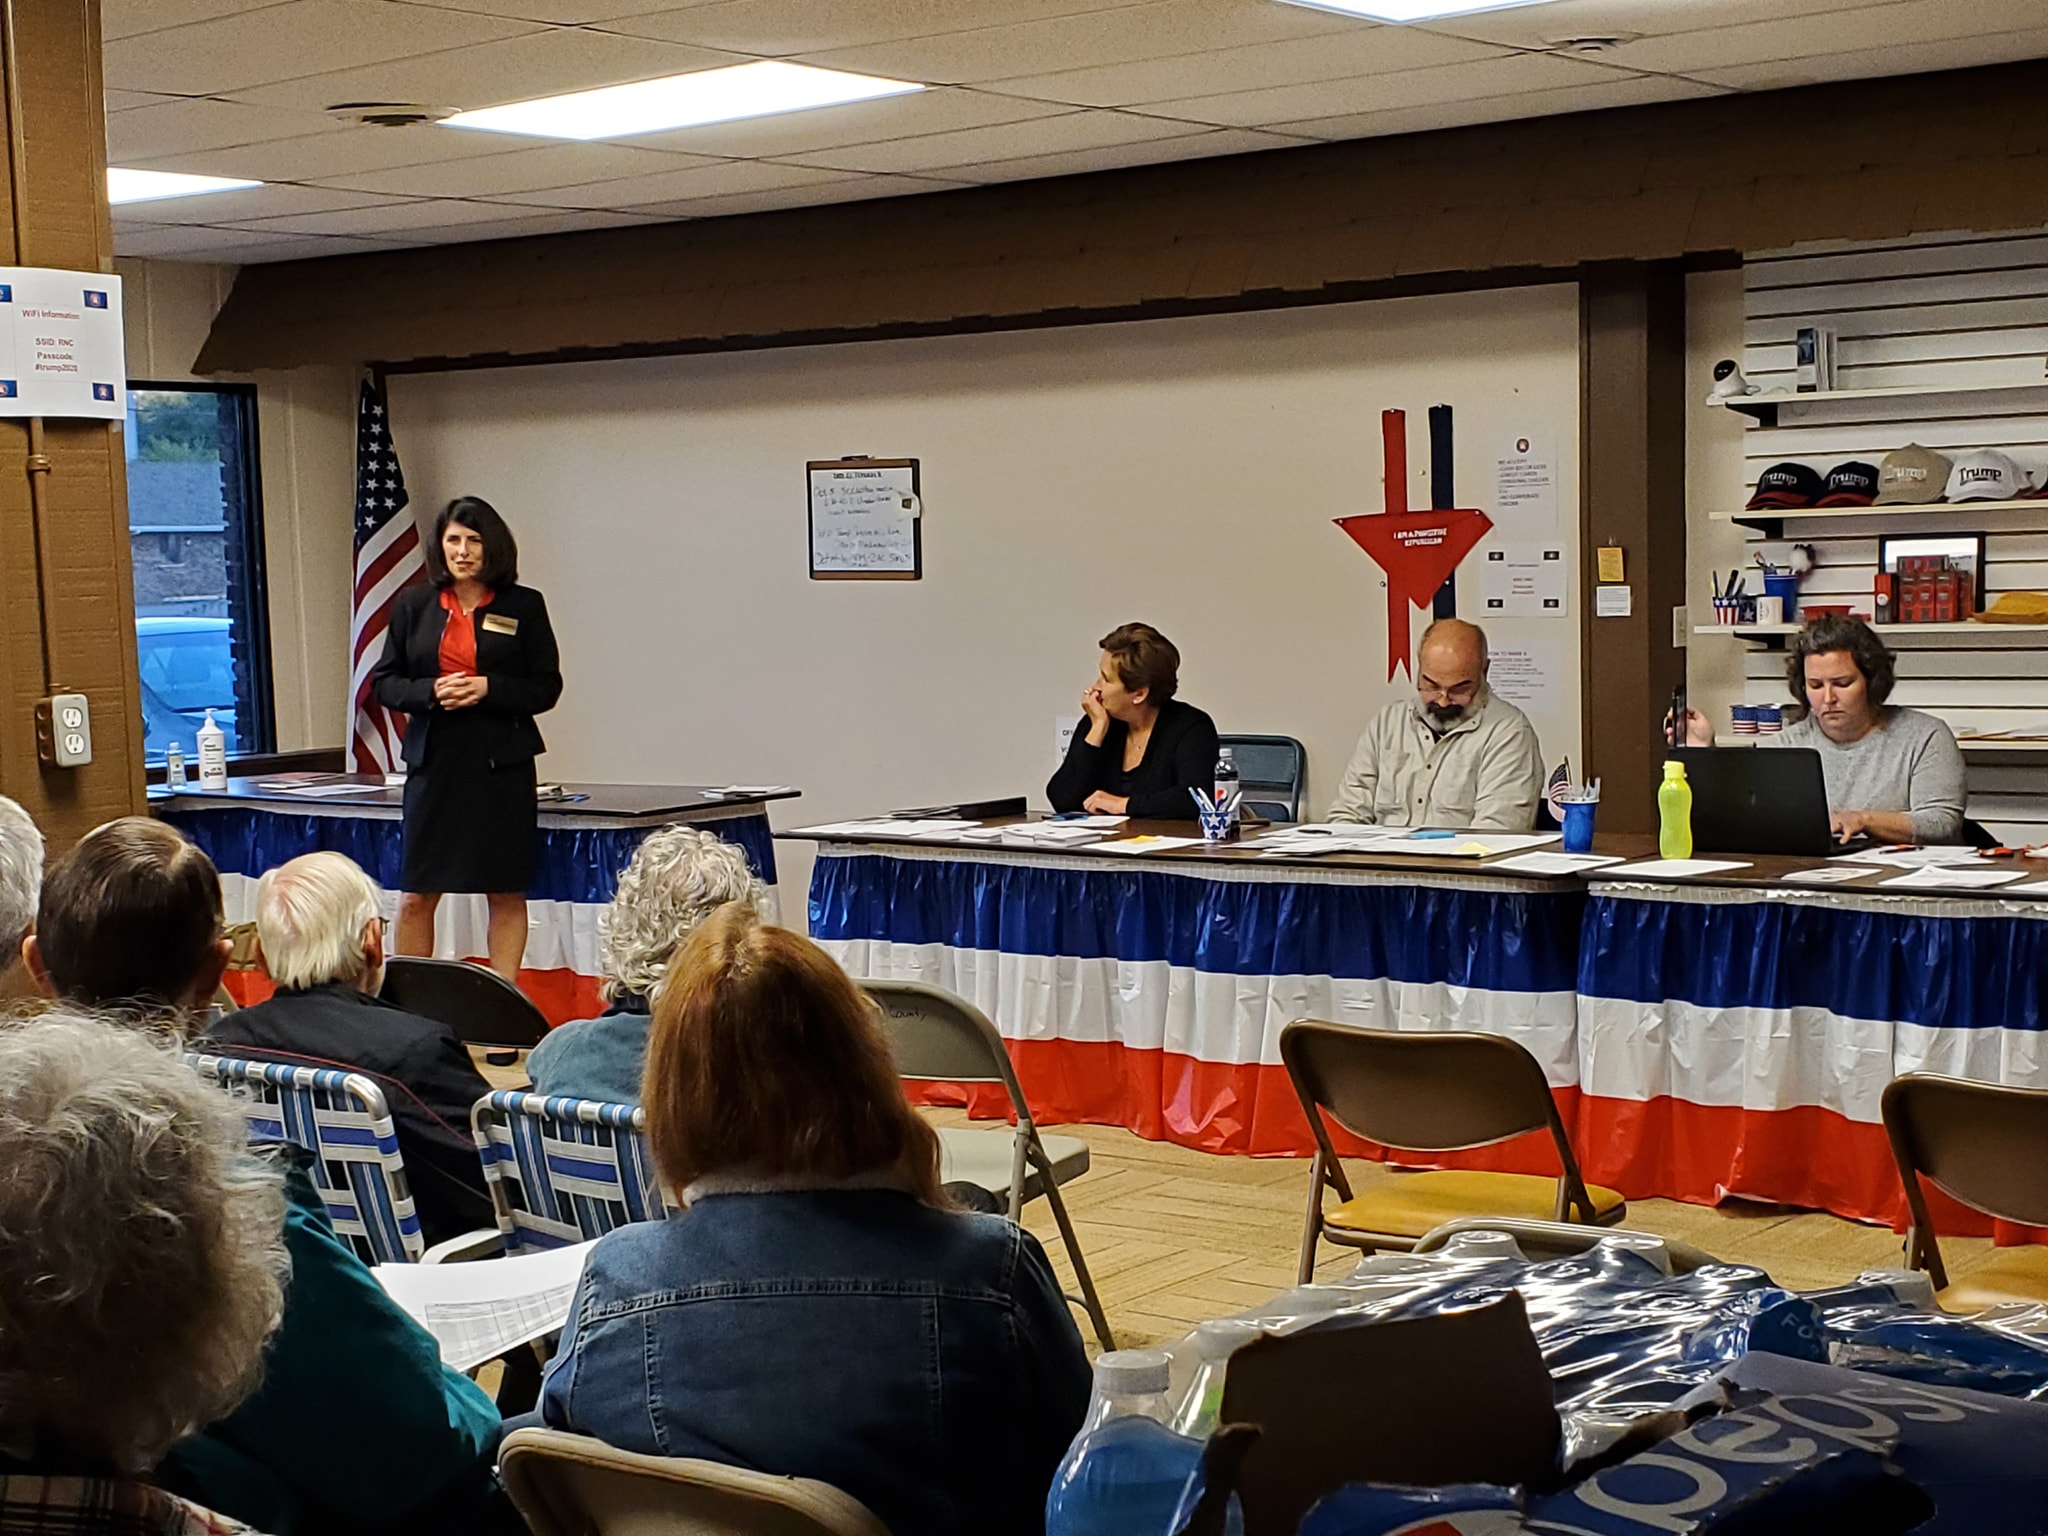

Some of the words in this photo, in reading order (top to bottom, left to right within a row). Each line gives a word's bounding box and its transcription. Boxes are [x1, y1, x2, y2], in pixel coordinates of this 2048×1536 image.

[41, 310, 80, 320] Information
[58, 338, 74, 347] RNC
[1762, 473, 1797, 488] Trump
[1828, 473, 1869, 488] Trump
[1886, 464, 1927, 482] Trump
[1958, 467, 2002, 487] Trump
[889, 1005, 928, 1022] County
[1573, 1379, 1999, 1535] pepsi
